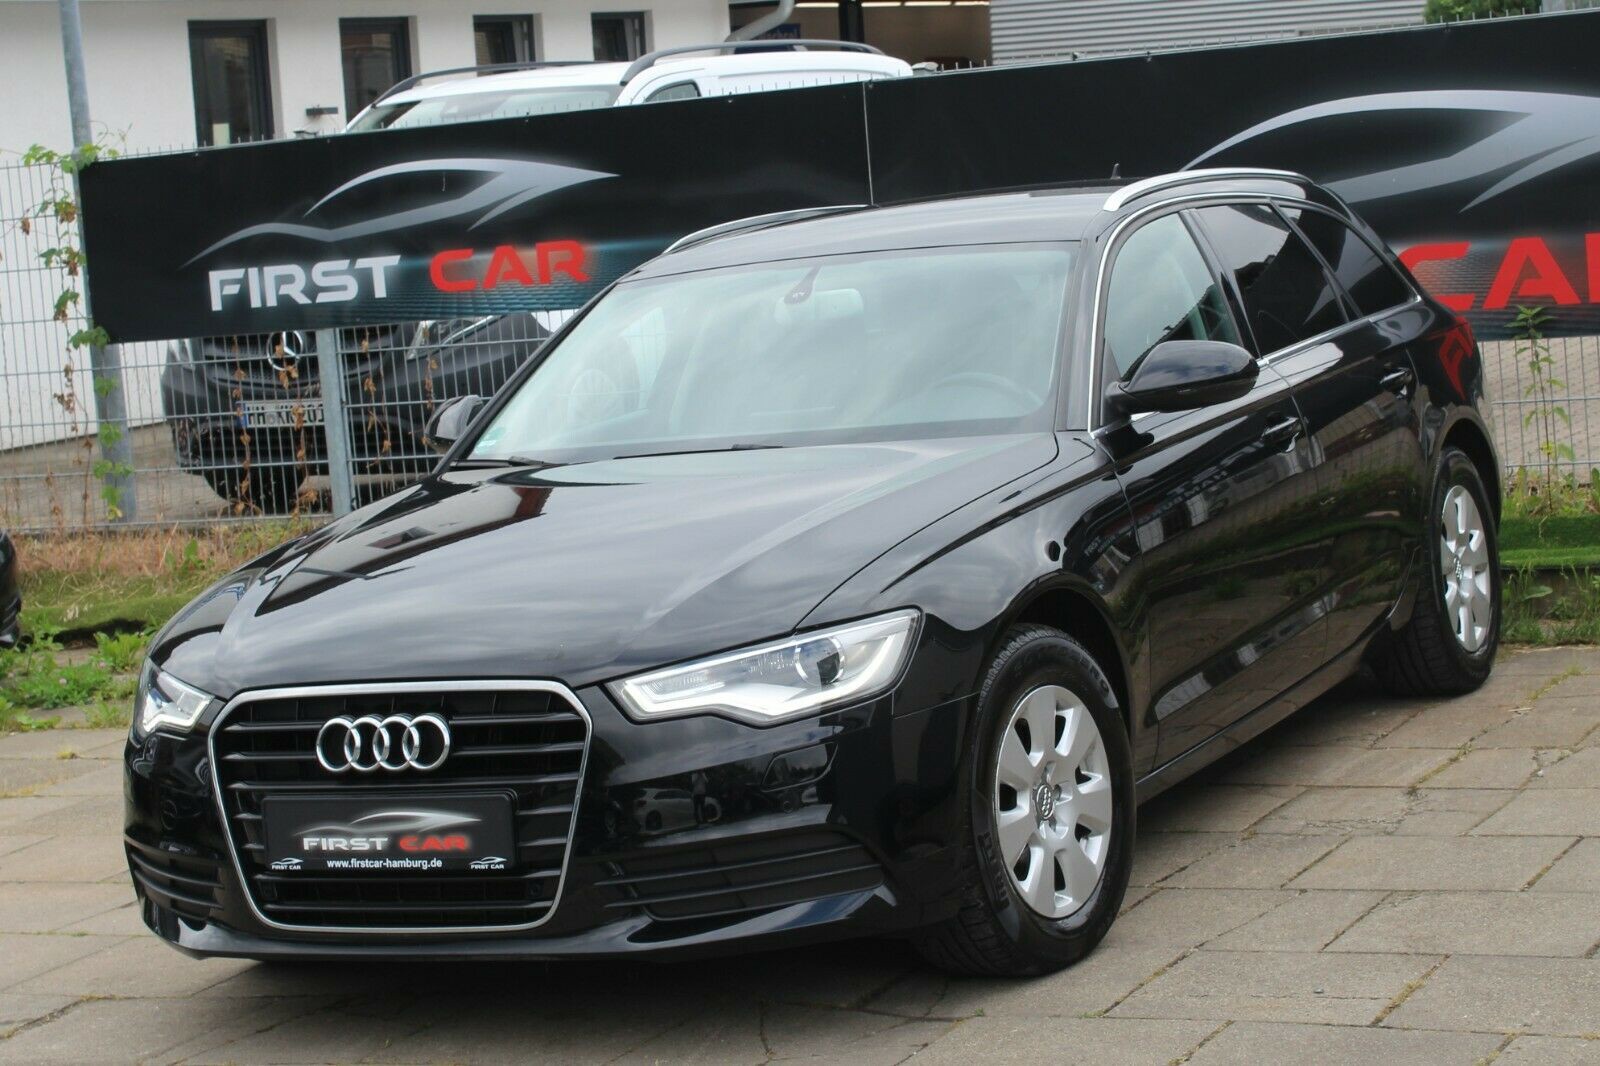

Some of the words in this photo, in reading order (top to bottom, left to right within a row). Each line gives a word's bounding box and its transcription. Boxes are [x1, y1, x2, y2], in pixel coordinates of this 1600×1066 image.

[208, 254, 401, 312] FIRST
[429, 239, 590, 293] CAR
[1397, 232, 1600, 311] CA
[302, 837, 389, 851] FIRST
[399, 835, 469, 852] CAR
[326, 857, 443, 870] www.firstcar-hamburg.de
